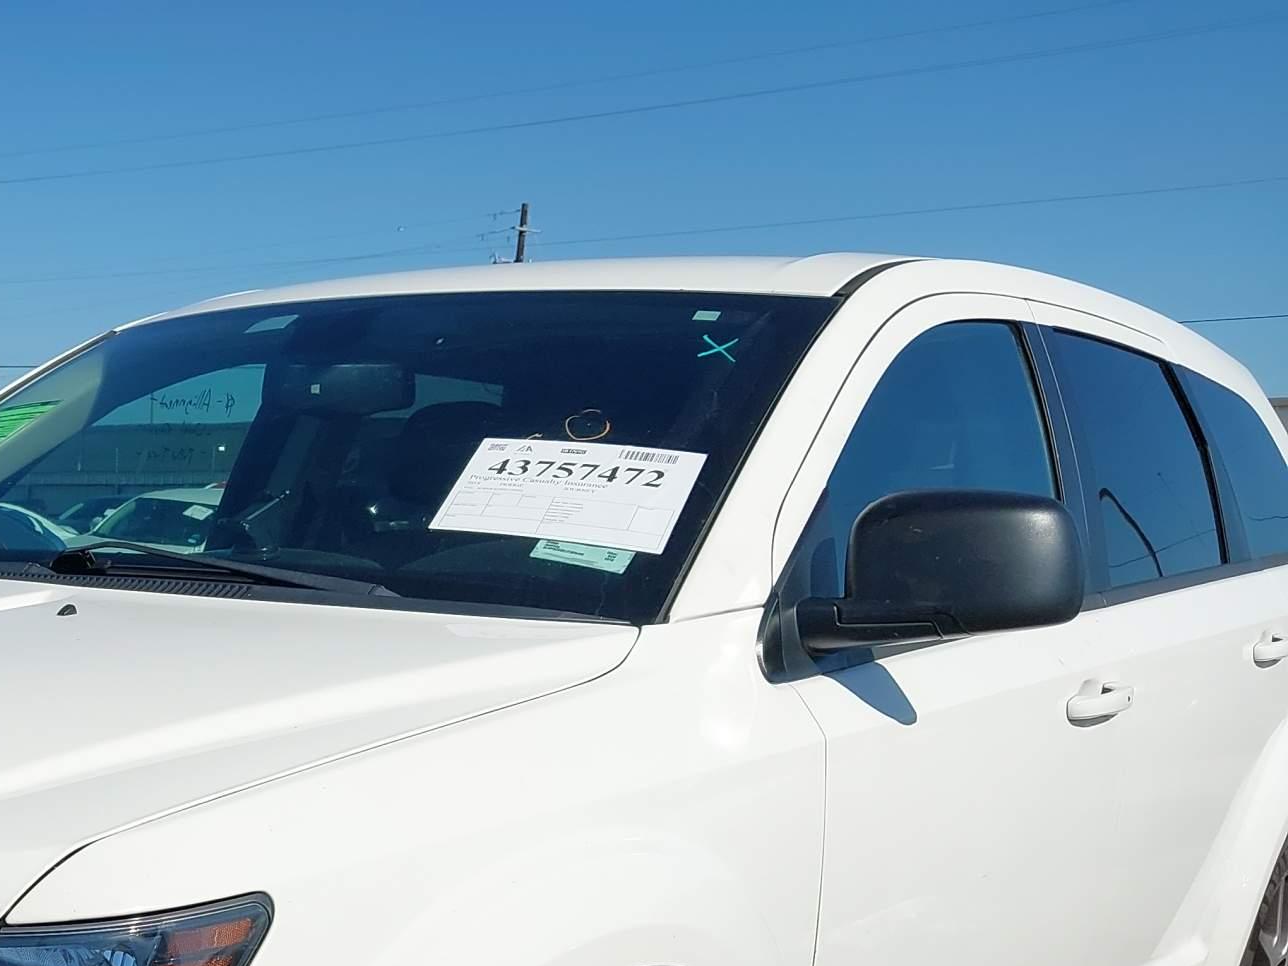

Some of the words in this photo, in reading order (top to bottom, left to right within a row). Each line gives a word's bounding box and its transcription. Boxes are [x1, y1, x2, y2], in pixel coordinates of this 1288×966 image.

[469, 474, 521, 482] Progressive
[522, 477, 561, 487] Casualty
[564, 479, 609, 489] Insurance
[487, 458, 666, 488] 43757472
